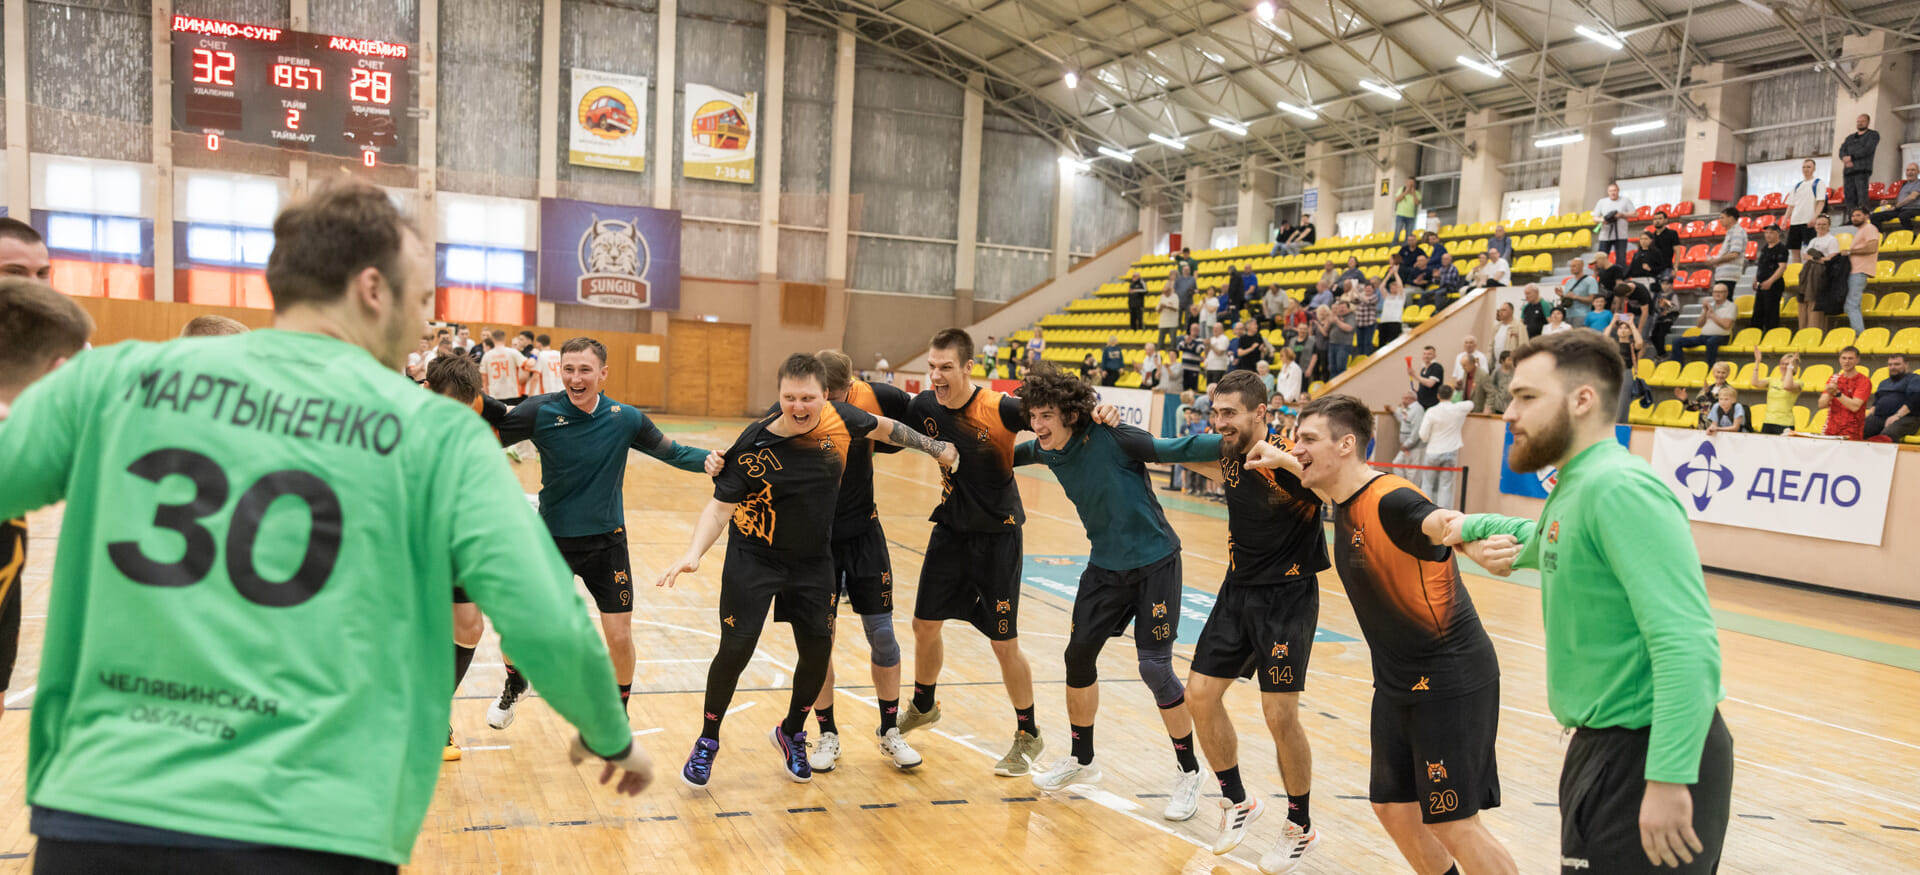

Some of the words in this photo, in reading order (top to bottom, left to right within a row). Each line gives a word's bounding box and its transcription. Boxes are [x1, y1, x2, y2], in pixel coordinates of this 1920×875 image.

[173, 16, 281, 41] ДИНАМО-СУНГ
[200, 39, 228, 50] СЧЕТ
[329, 37, 407, 58] АКАДЕМИЯ
[193, 48, 235, 86] 32
[277, 56, 310, 67] ВРЕМЯ
[358, 58, 384, 70] СЧЕТ
[350, 67, 392, 104] 28
[281, 99, 307, 110] ТАЙМ
[286, 109, 300, 129] 2
[207, 134, 219, 151] 0
[271, 130, 316, 143] ТАЙМ-АУТ
[363, 150, 376, 167] 0
[590, 279, 638, 296] SUNGUL
[490, 360, 509, 379] 34
[124, 367, 402, 456] МАРТЫНЕНКО
[1114, 405, 1143, 425] ЕЛО
[738, 447, 783, 478] 31
[1747, 467, 1861, 508] ДЕЛО
[107, 446, 343, 608] 30
[619, 589, 630, 606] 9
[881, 590, 893, 607] 7
[998, 618, 1008, 634] 8
[1152, 622, 1170, 641] 13
[1268, 665, 1293, 684] 14
[99, 671, 279, 717] ЧЕЛЯБИНСКАЯ
[130, 703, 237, 741] ОБЛАСТЬ
[1429, 789, 1459, 814] 20
